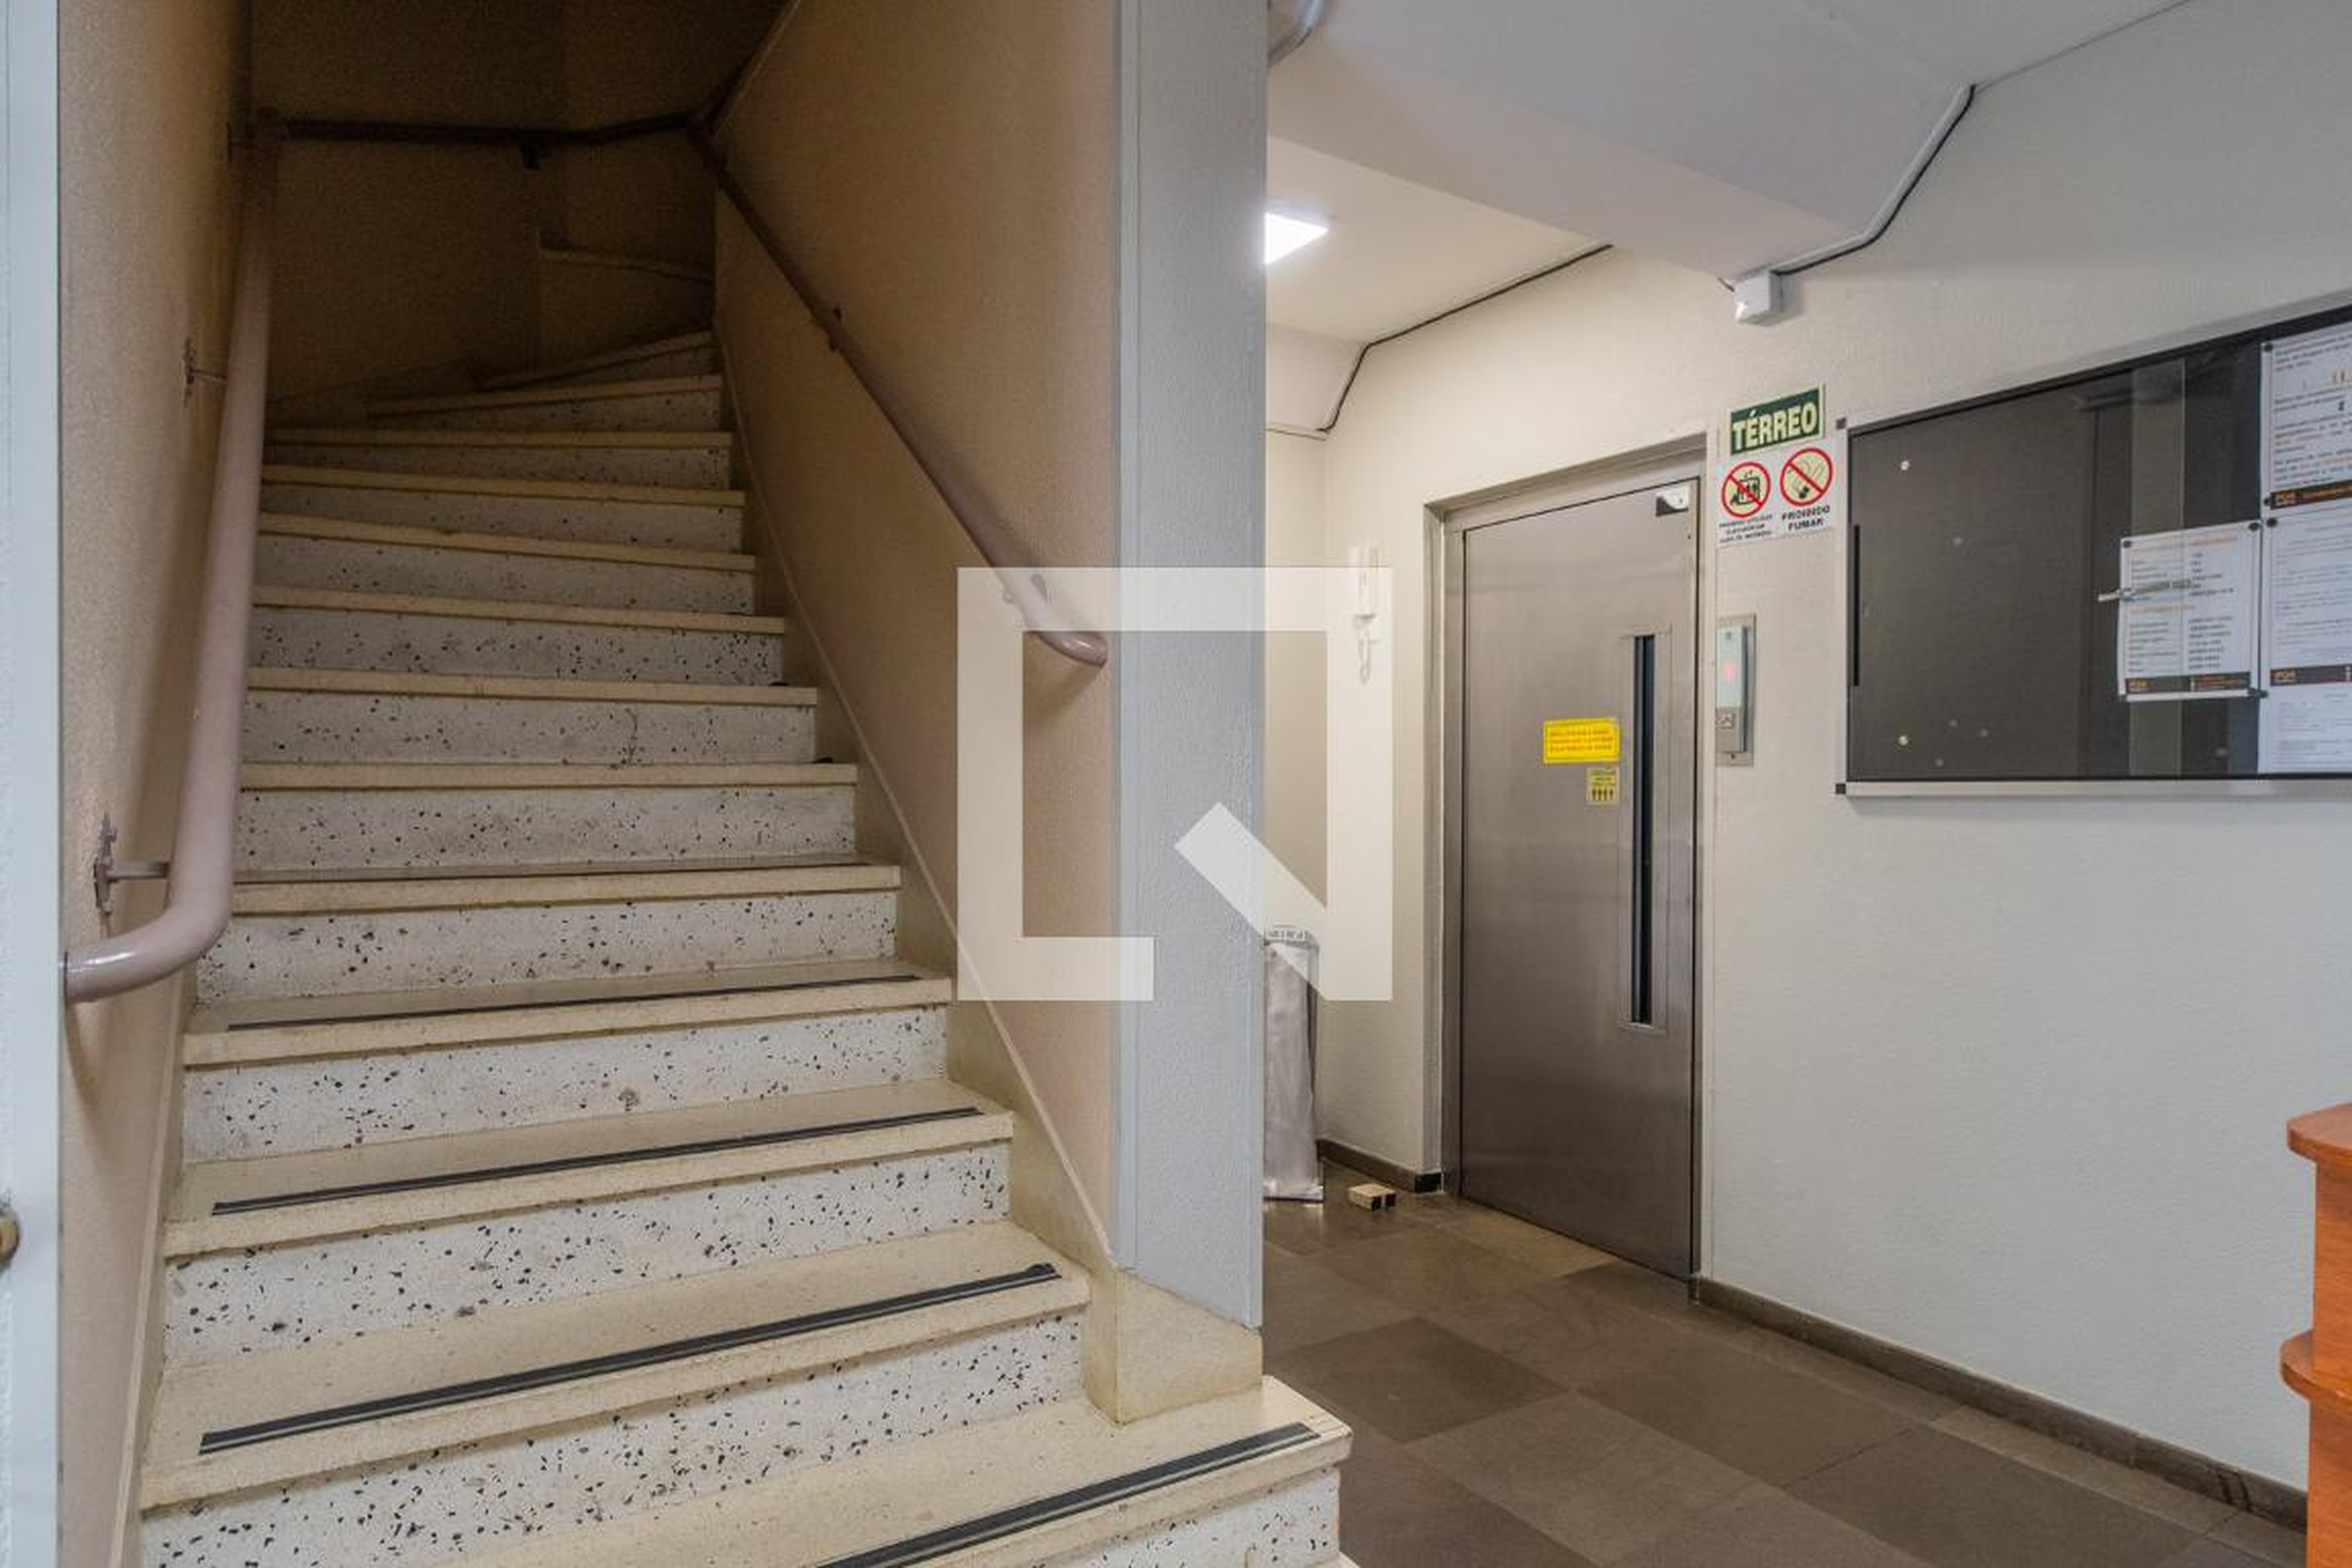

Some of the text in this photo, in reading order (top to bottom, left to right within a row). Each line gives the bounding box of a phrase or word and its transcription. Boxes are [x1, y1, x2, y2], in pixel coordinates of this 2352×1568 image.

[1733, 401, 1818, 450] TÉRREO
[1782, 505, 1830, 521] PROIBIDO
[1788, 518, 1824, 531] FUMAR
